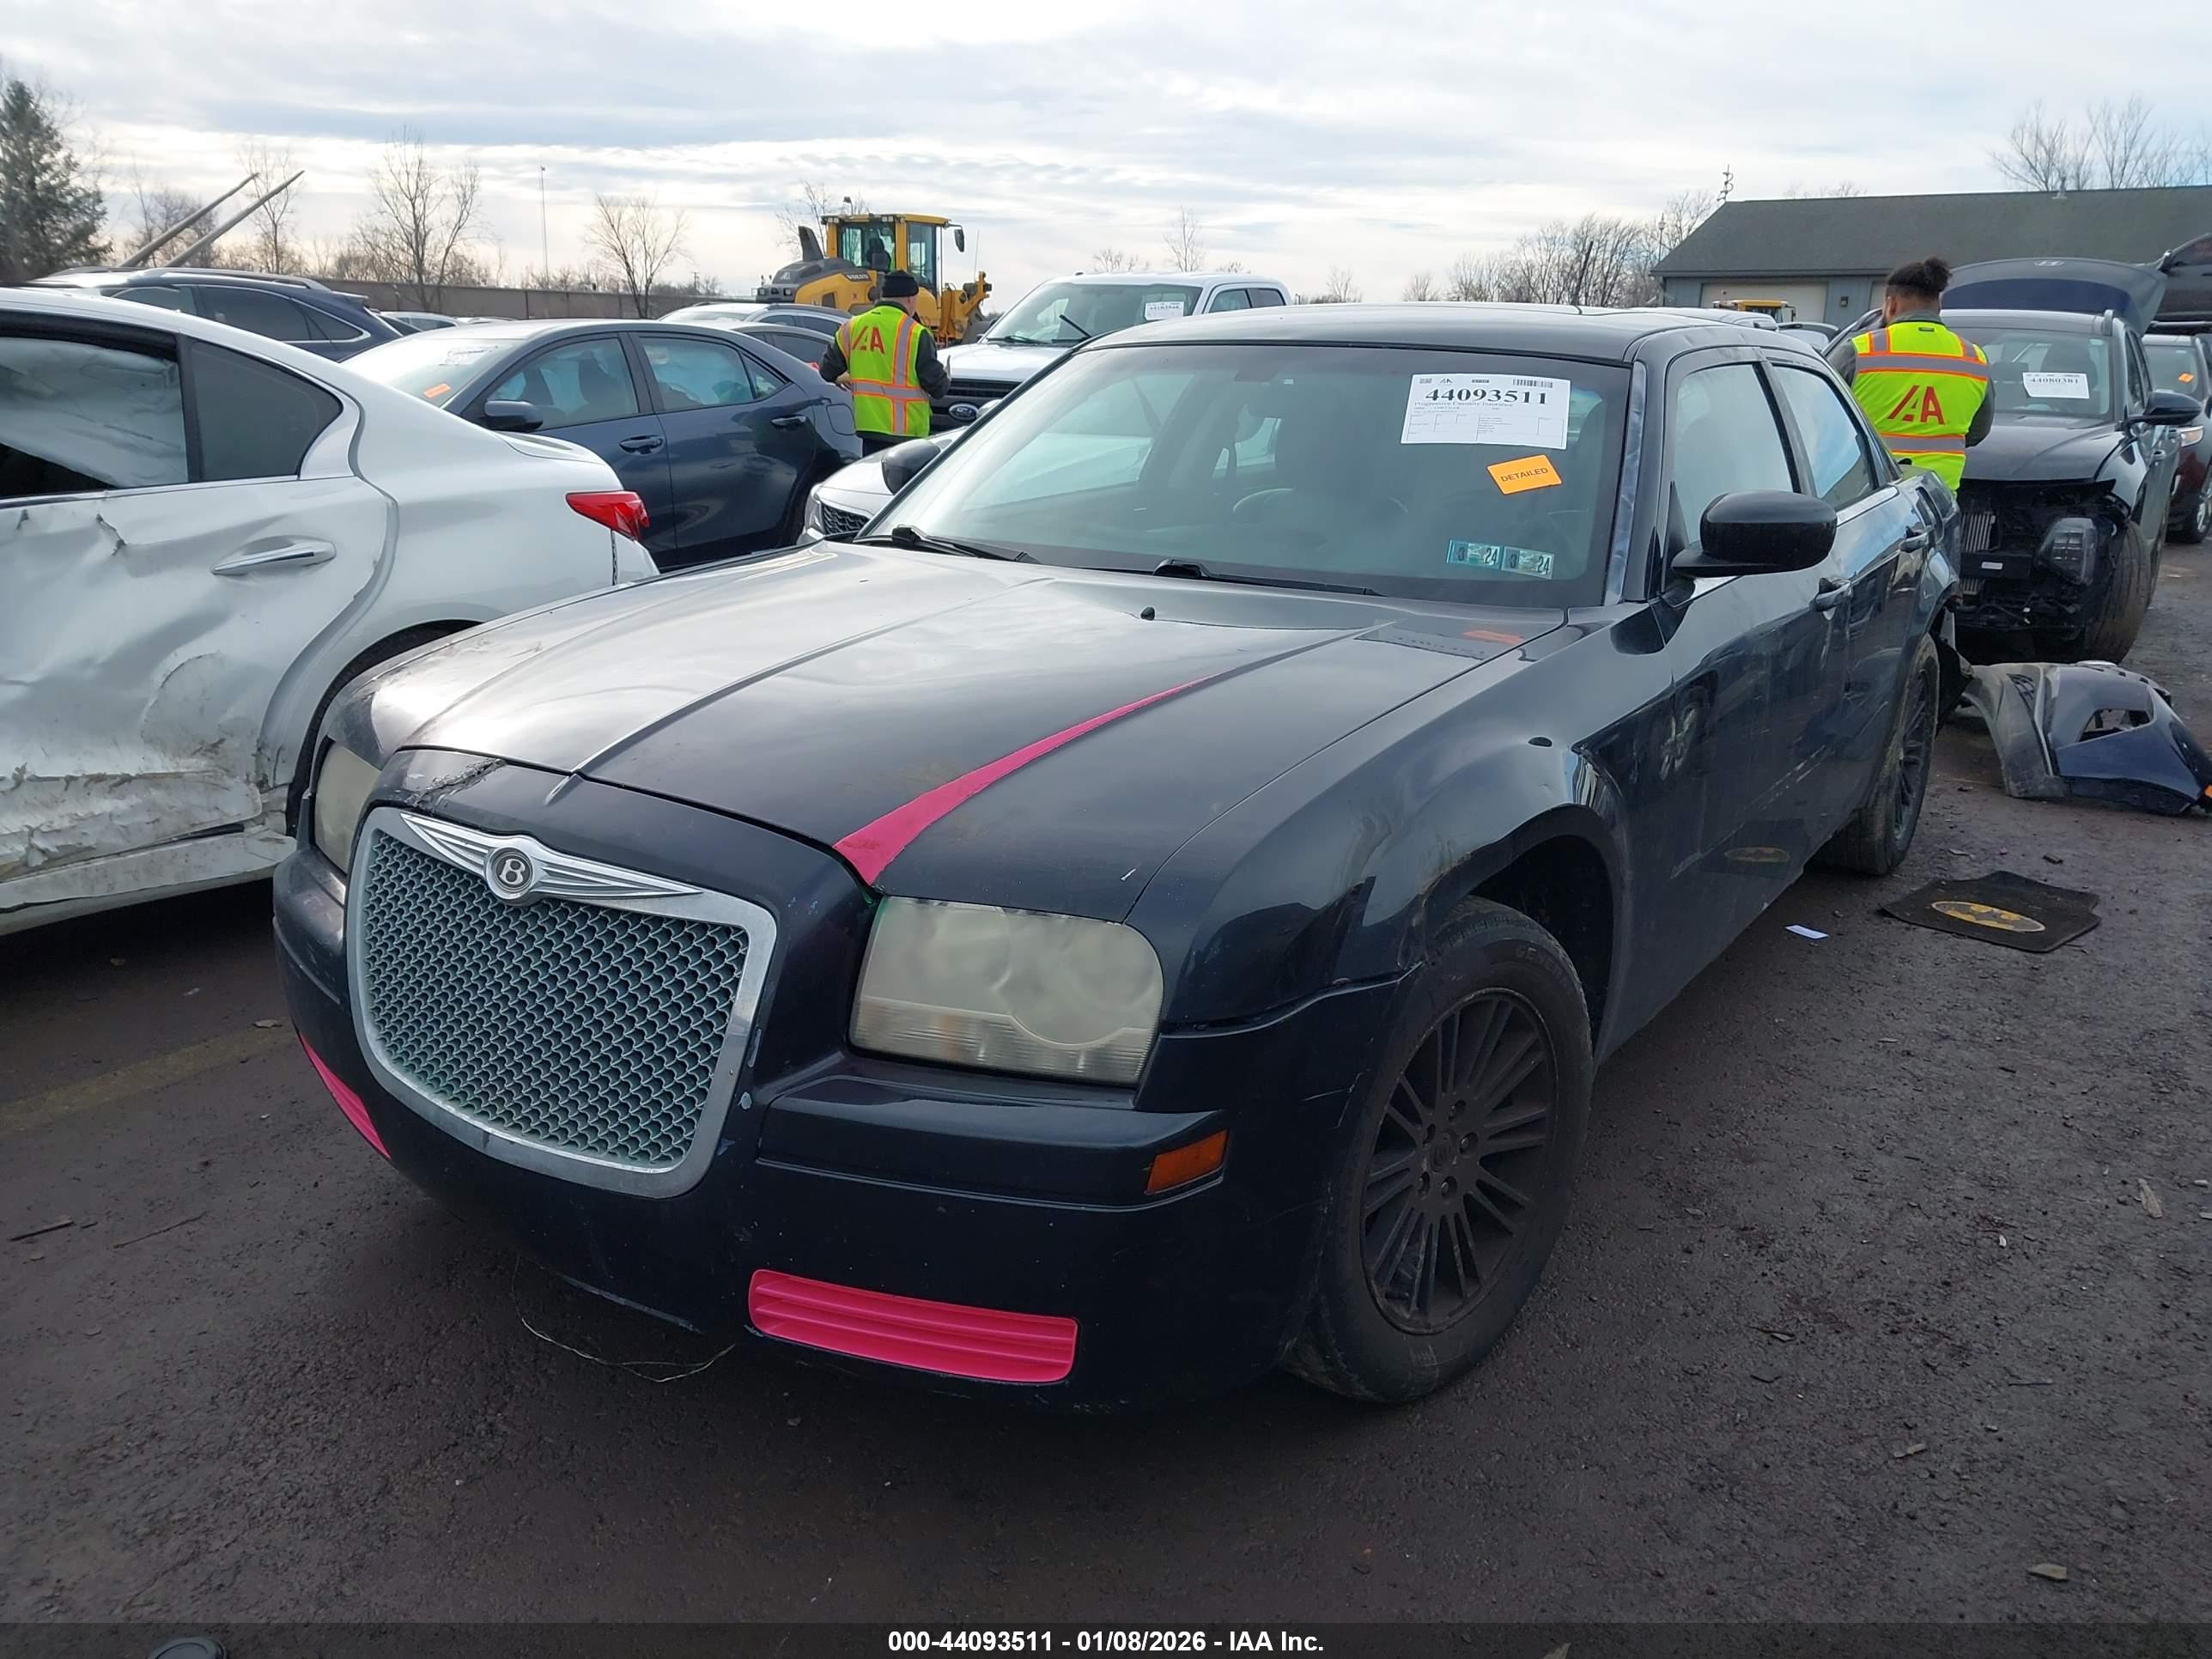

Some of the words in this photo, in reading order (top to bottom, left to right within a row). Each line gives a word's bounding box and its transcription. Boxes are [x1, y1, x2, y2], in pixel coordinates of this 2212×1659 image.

[1425, 389, 1547, 405] 44093511
[1500, 467, 1548, 483] DETAILED
[1457, 547, 1465, 562] 3
[1484, 548, 1498, 564] 24
[1510, 554, 1518, 569] 3
[1537, 556, 1550, 575] 24
